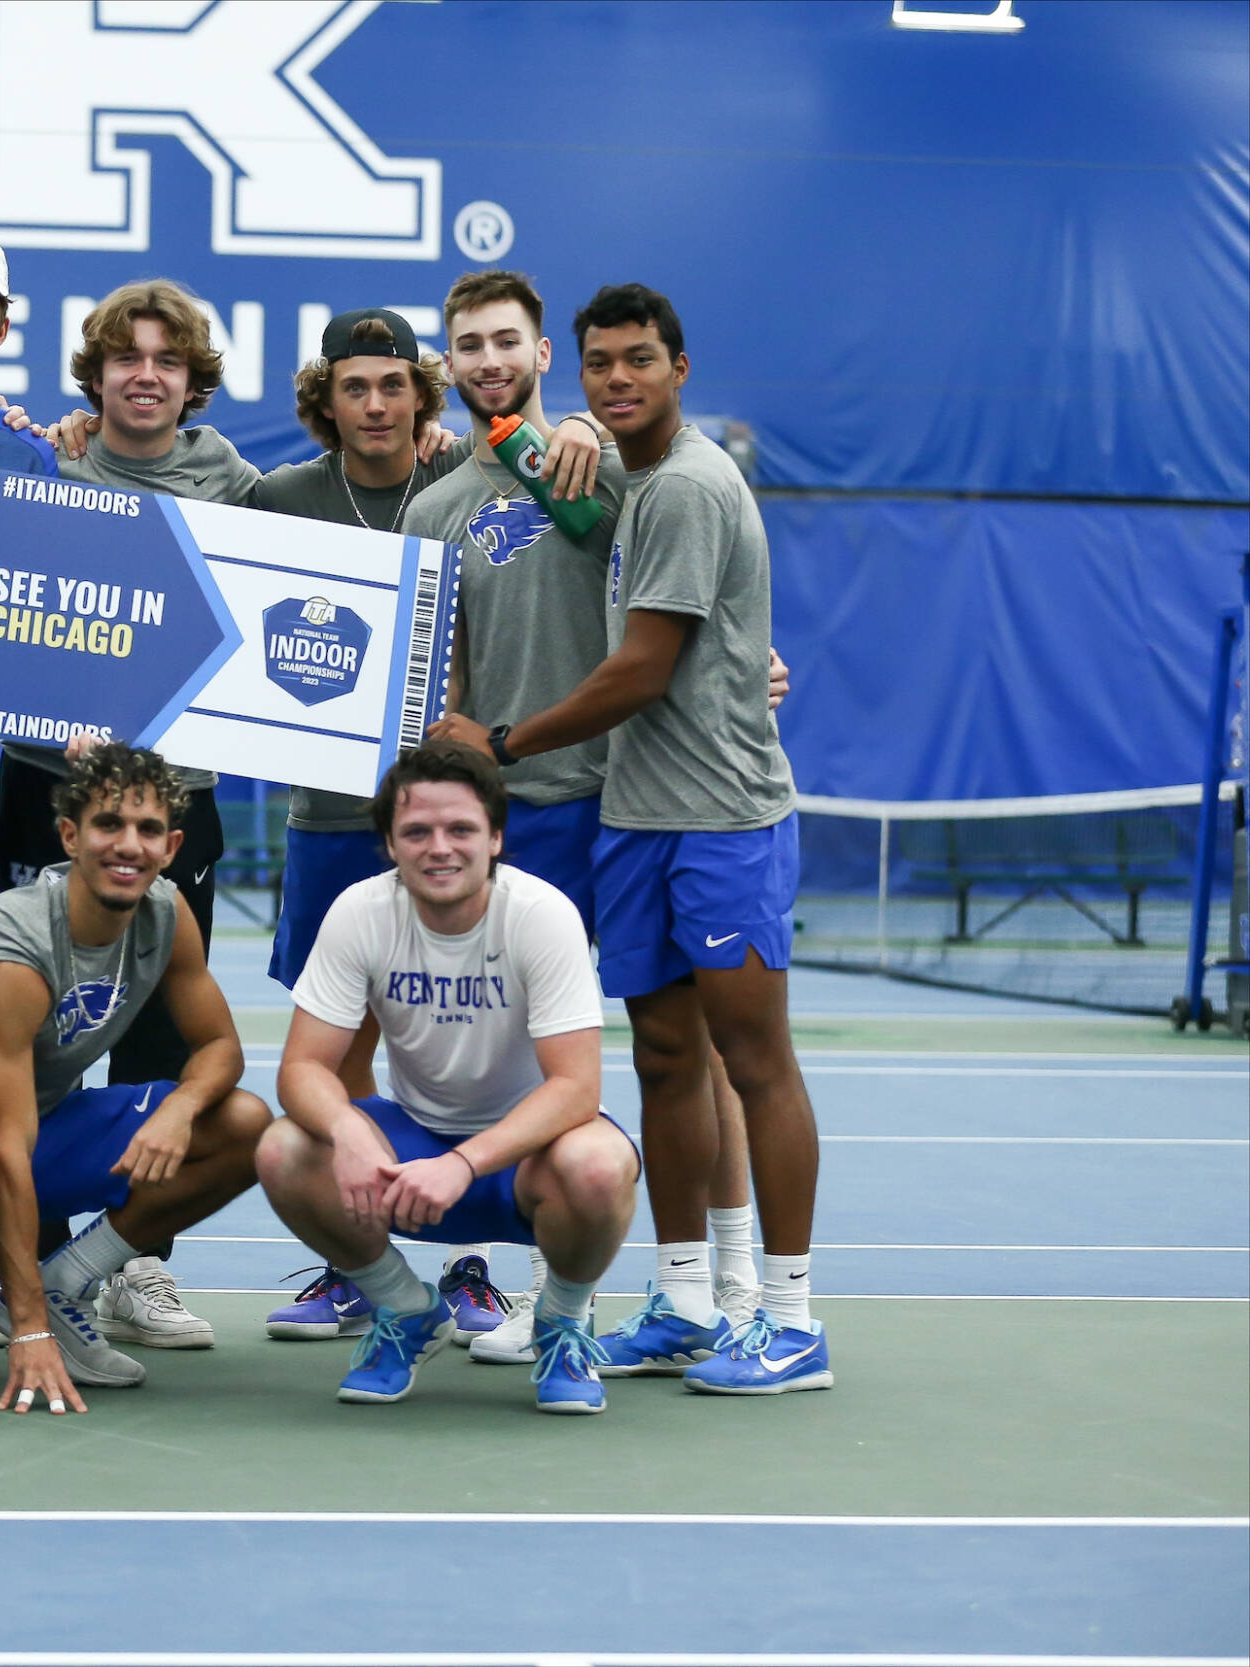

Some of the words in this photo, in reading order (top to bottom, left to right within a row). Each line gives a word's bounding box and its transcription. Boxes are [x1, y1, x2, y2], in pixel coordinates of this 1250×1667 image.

[3, 476, 141, 517] #ITAINDOORS
[57, 576, 122, 619] YOU
[130, 588, 166, 626] IN
[299, 601, 337, 622] ITA
[322, 632, 340, 642] TEAM
[269, 633, 358, 673] INDOOR
[277, 661, 345, 681] CHAMPIONSHIPS
